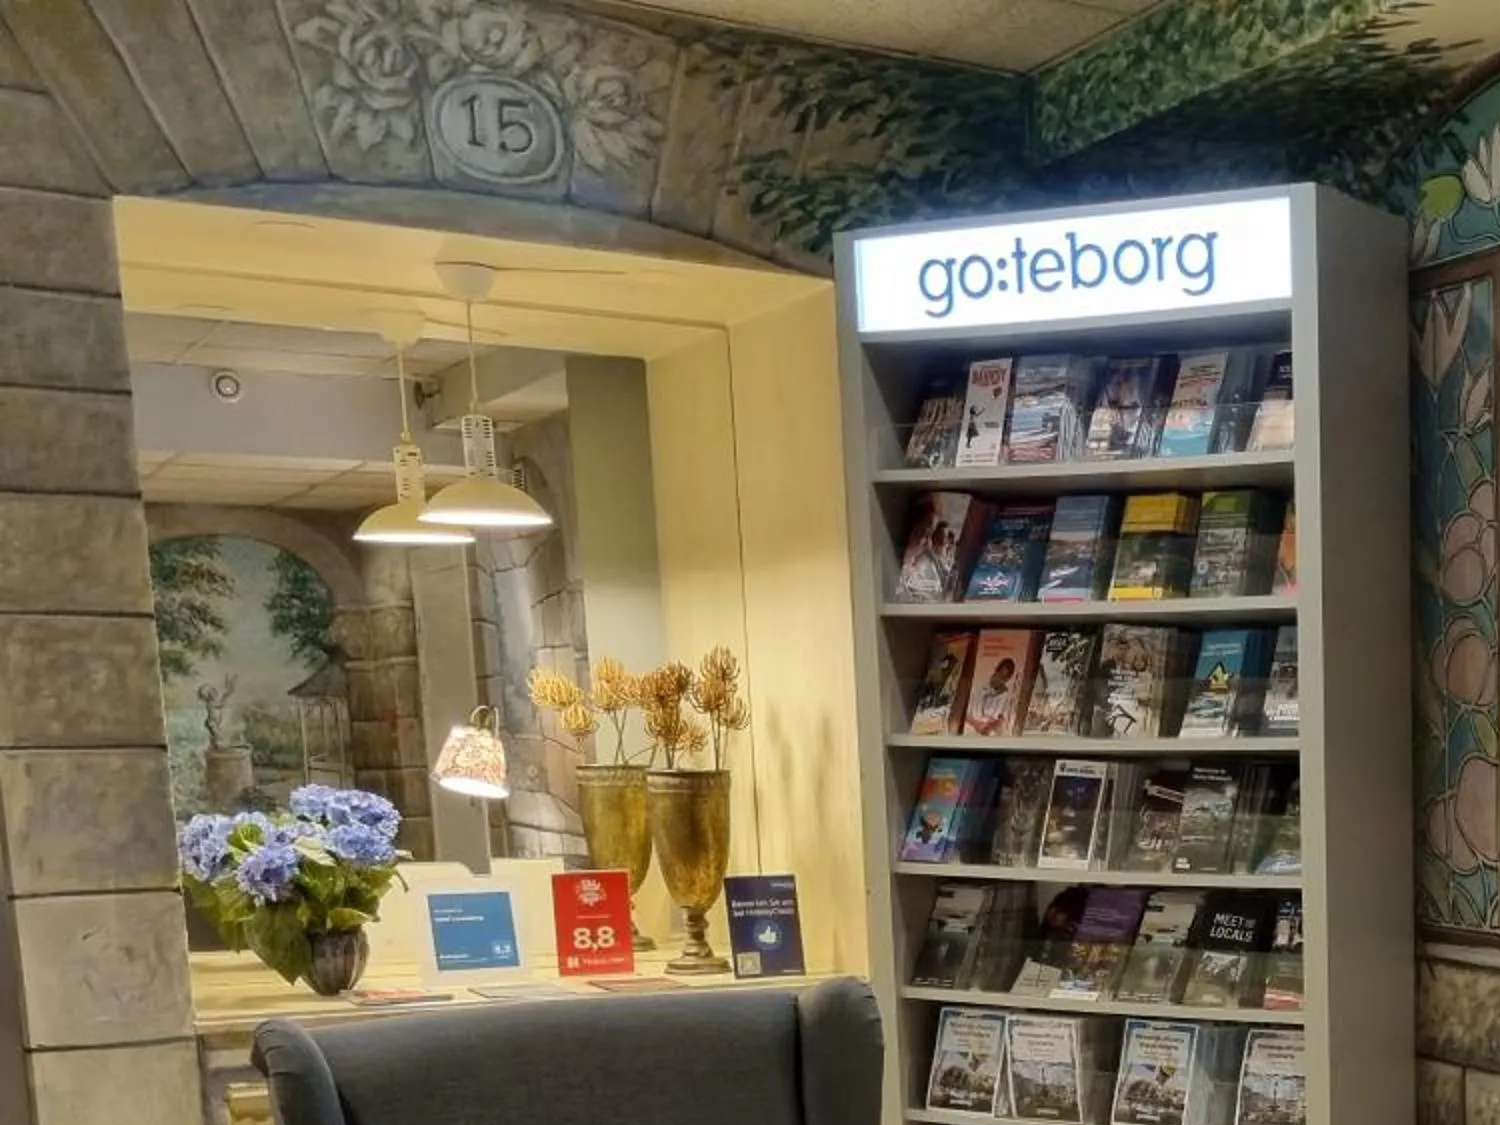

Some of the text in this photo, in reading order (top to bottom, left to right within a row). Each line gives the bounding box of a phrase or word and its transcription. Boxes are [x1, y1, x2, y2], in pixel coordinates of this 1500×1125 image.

[461, 93, 535, 154] 15
[918, 231, 1219, 319] go:teborg
[573, 925, 616, 952] 8,8
[1209, 926, 1254, 943] LOCALS
